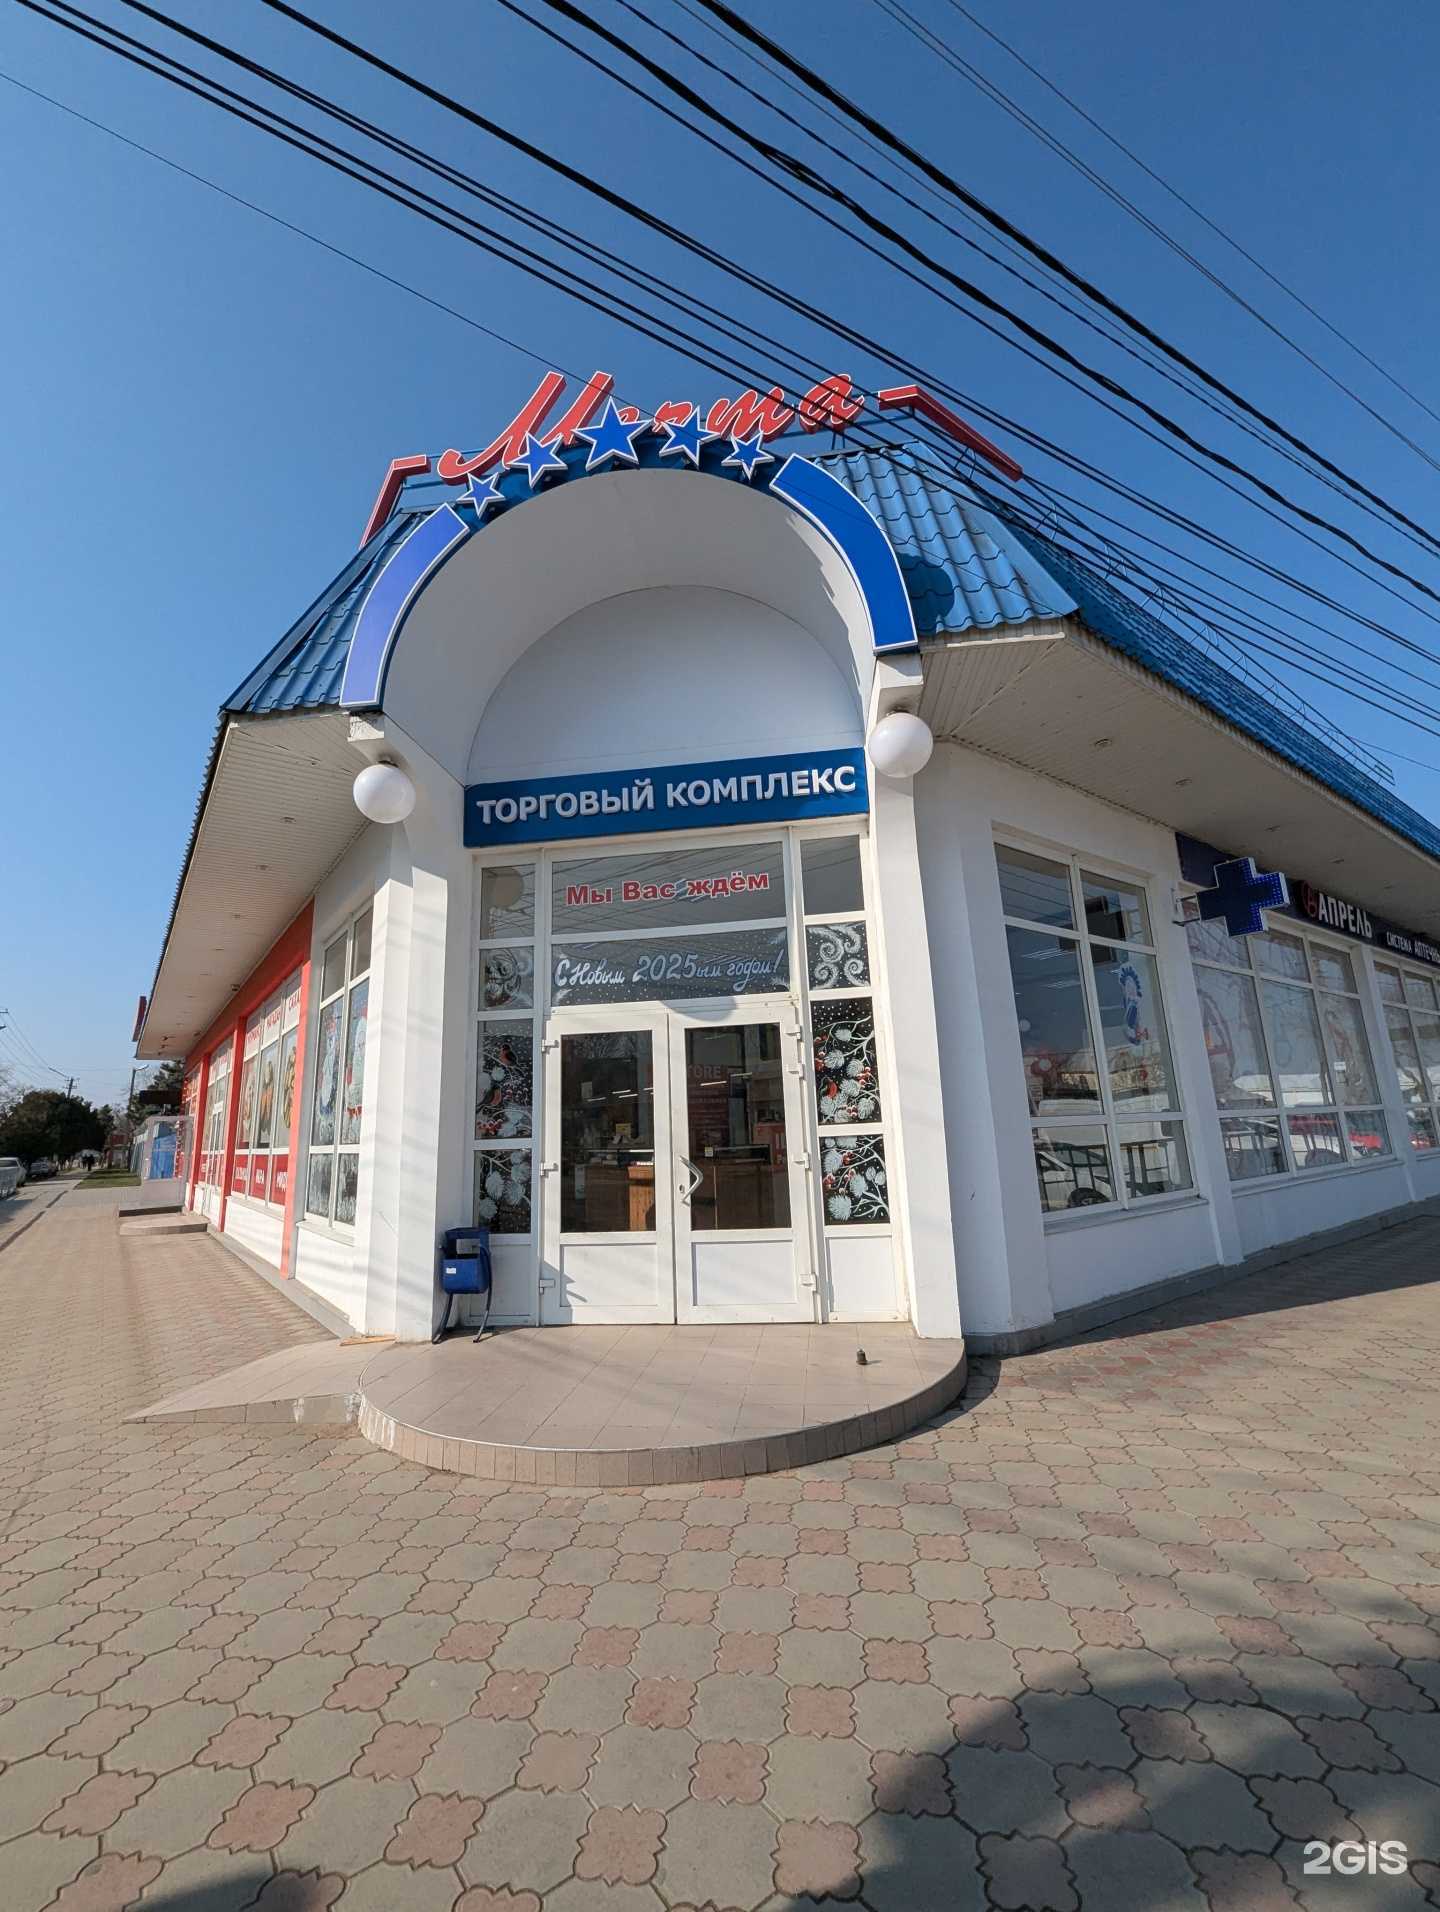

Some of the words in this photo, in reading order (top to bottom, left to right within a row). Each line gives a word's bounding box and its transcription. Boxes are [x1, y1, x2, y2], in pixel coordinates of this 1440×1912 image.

[477, 778, 656, 825] ТОРГОВЫЙ
[667, 765, 857, 808] КОМПЛЕКС
[566, 884, 613, 906] Мы
[622, 879, 676, 902] Вас
[686, 870, 770, 898] ждём
[1318, 892, 1373, 939] АПРЕЛЬ
[555, 958, 571, 987] С
[569, 957, 625, 986] Новым
[726, 949, 786, 992] годом!
